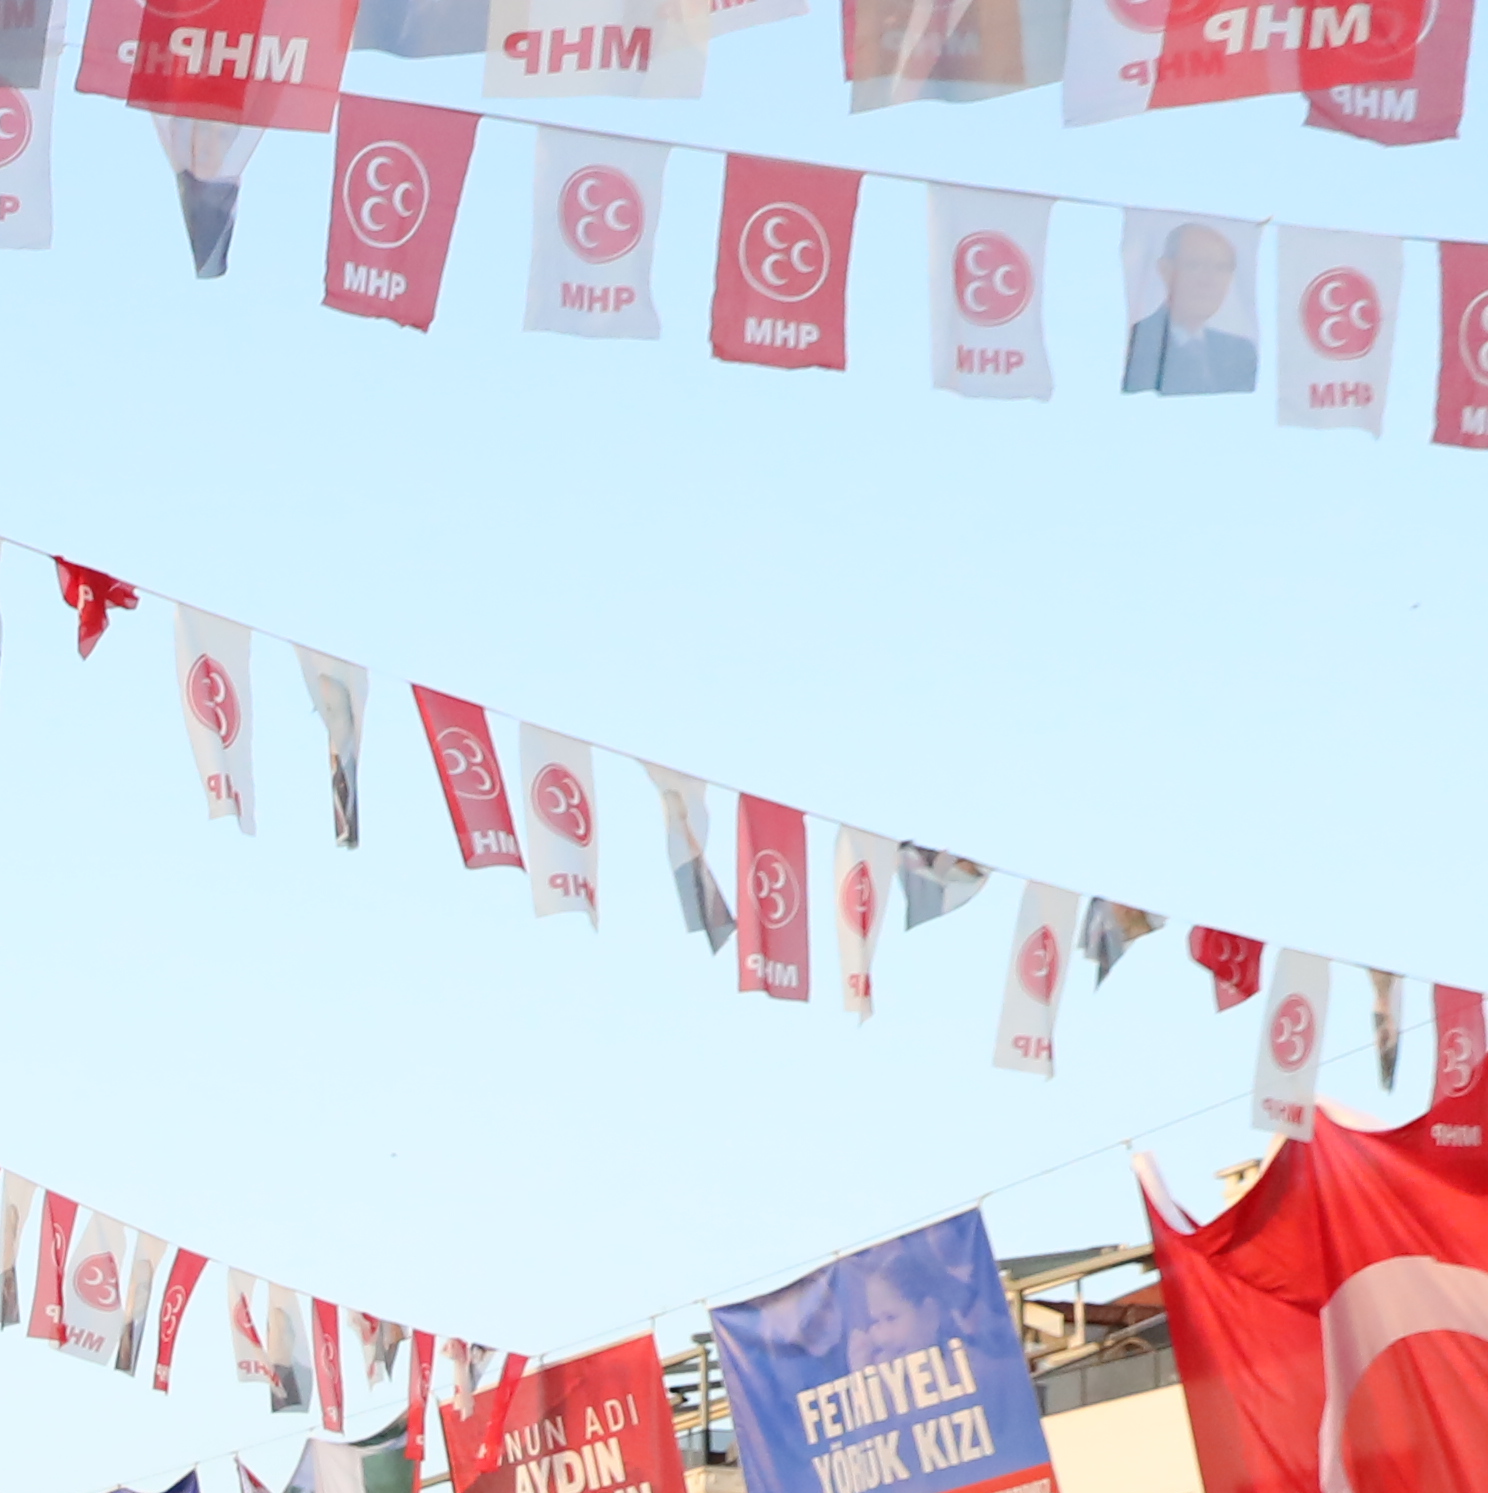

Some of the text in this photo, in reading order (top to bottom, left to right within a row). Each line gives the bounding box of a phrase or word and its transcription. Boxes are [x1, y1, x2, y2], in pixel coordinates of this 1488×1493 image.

[343, 261, 408, 302] MHP
[561, 281, 636, 313] MHP
[744, 316, 821, 351] MHP
[956, 344, 1026, 375] MHP
[796, 1337, 978, 1446] FETHİYELİ
[498, 1392, 640, 1466] NUN ADI
[911, 1404, 996, 1475] KIZI
